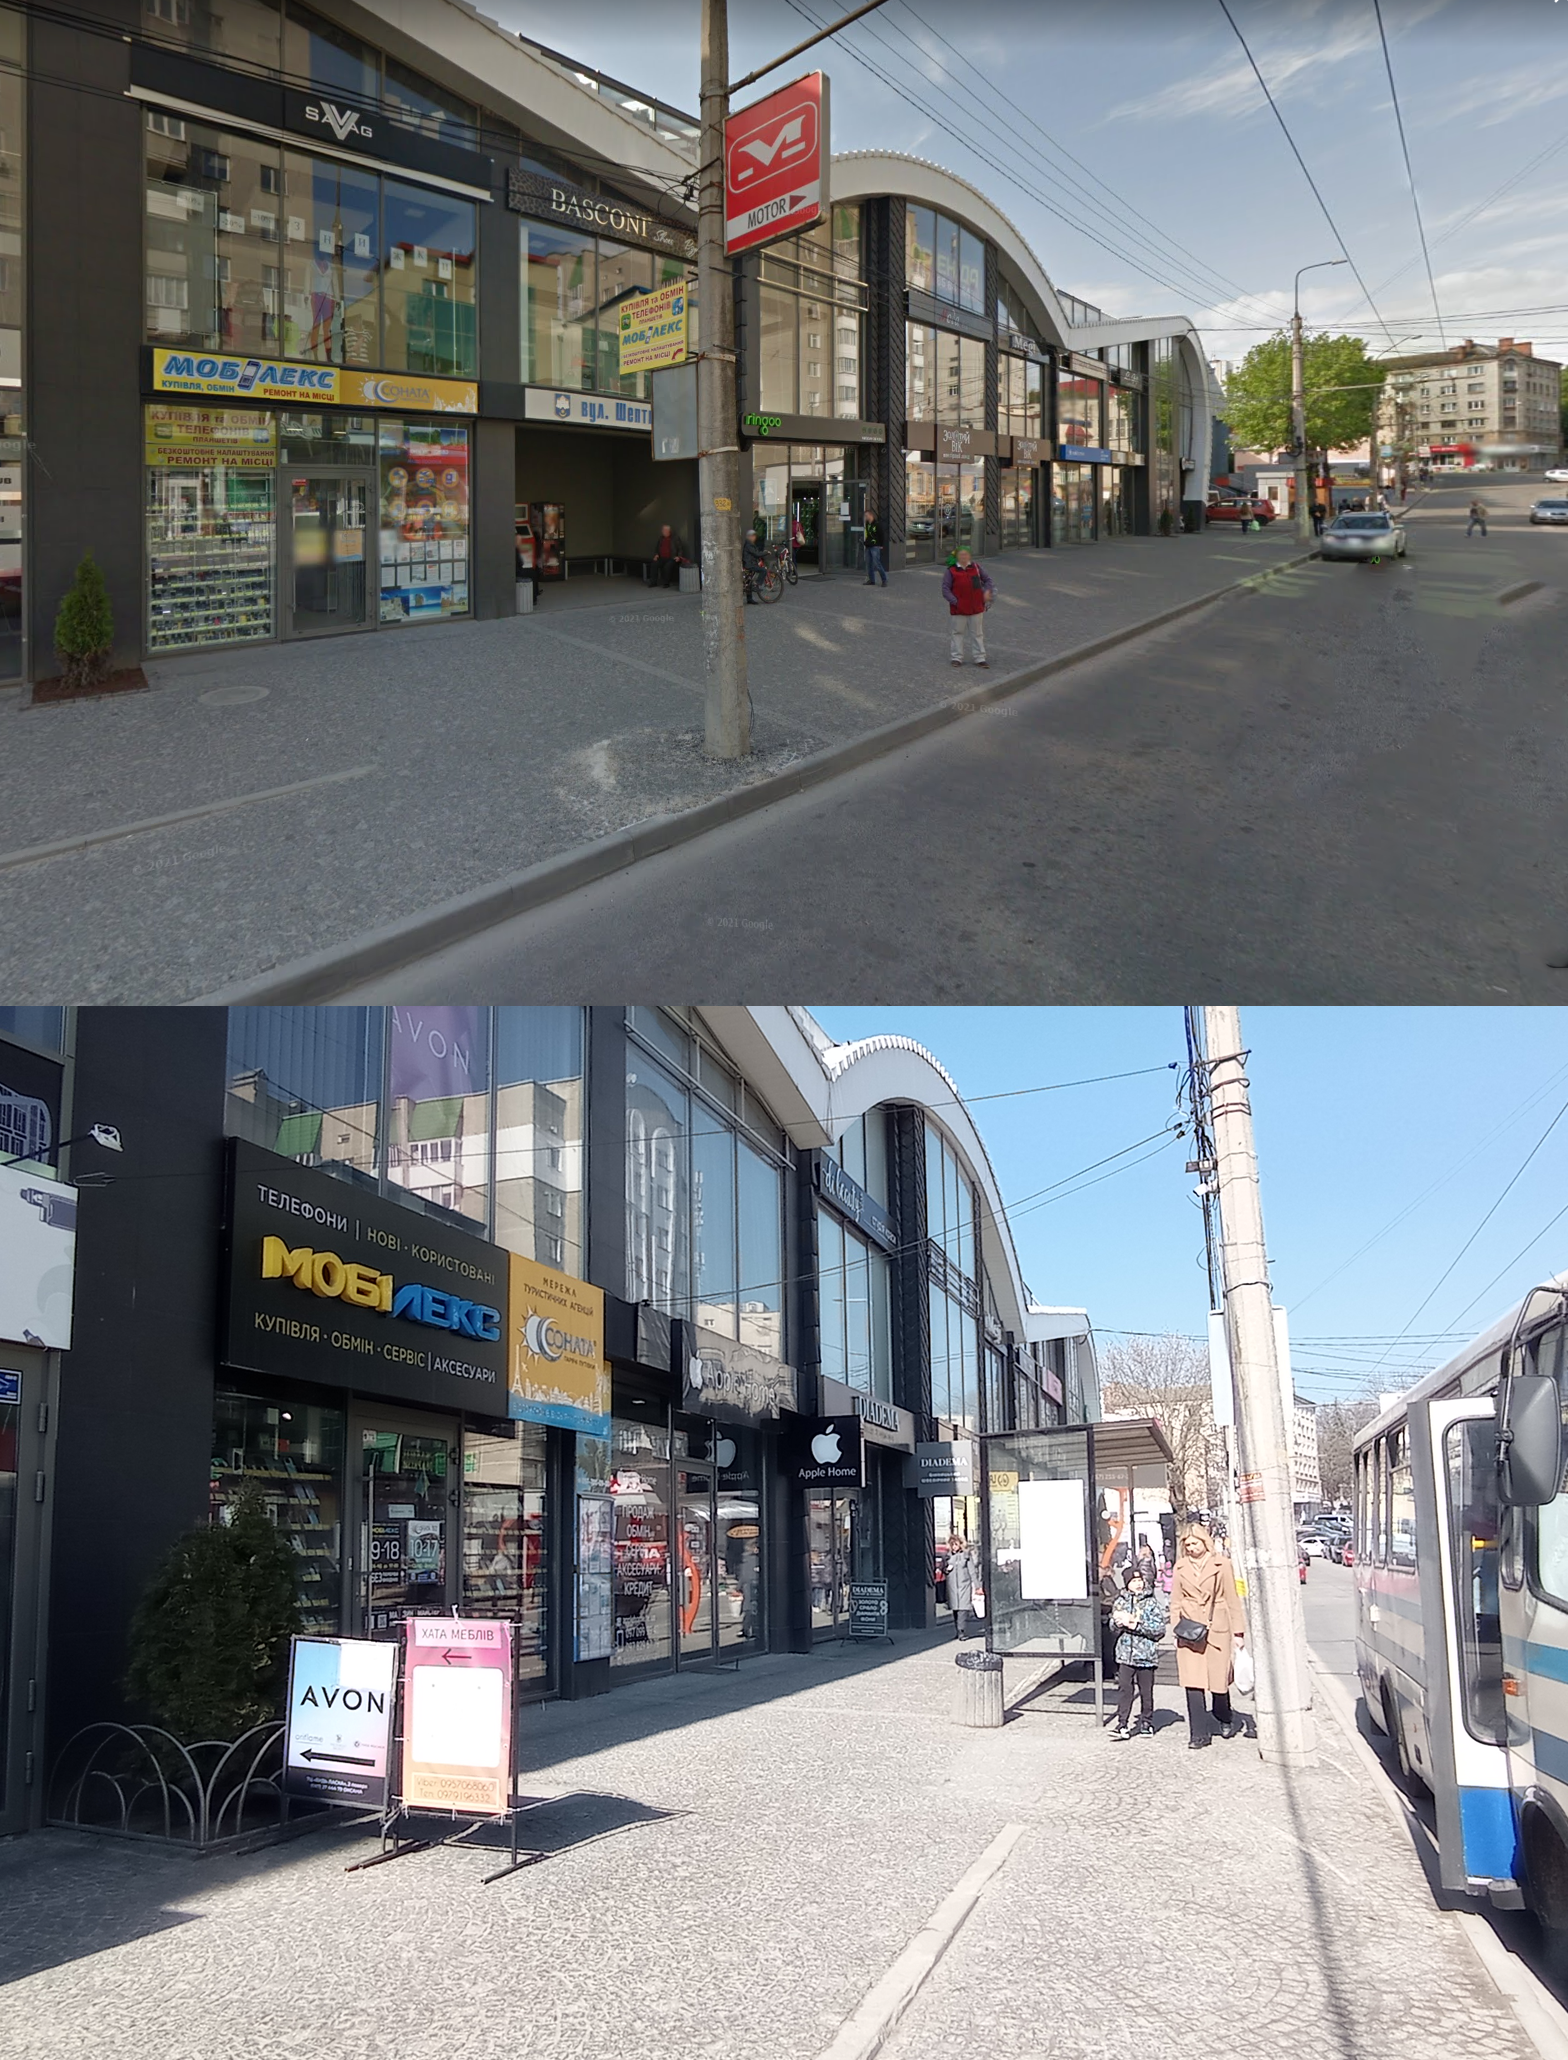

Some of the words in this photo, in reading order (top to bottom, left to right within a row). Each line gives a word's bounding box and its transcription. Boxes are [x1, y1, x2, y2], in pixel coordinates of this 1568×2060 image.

[551, 188, 652, 237] BASCONI
[747, 198, 787, 229] MOTOR
[621, 297, 650, 314] КУПІВЛЯ
[651, 296, 659, 306] та
[660, 286, 685, 302] ОБМІН
[632, 301, 672, 320] ТЕЛЕФОНІВ
[623, 356, 645, 367] РЕМОНТ
[645, 354, 653, 362] НА
[654, 351, 671, 362] МІСЦІ
[161, 380, 205, 392] КУПІВЛЯ,
[206, 384, 235, 393] ОБМІН
[379, 385, 431, 400] СОНАТА
[263, 388, 297, 399] РЕМОНТ
[298, 391, 310, 400] НА
[311, 392, 335, 402] МІСЦІ
[581, 401, 609, 423] вул.
[176, 424, 250, 437] ТЕЛЕФОНІВ
[744, 413, 782, 436] ringoo
[157, 447, 215, 456] БЕЗКОШТОВНЕ
[216, 449, 275, 457] НАЛАШТУВАННЯ
[167, 456, 218, 465] РЕМОНТ
[221, 458, 238, 466] НА
[240, 459, 273, 467] МІСЦІ
[257, 1184, 348, 1233] ТЕЛЕФОНИ
[367, 1227, 401, 1252] НОВІ
[411, 1243, 495, 1285] КОРИСТОВАНІ
[543, 1276, 577, 1298] МЕРЕЖА
[524, 1283, 568, 1308] ТУРИСТИЧНИХ
[570, 1302, 594, 1317] АГЕНЦІЙ
[254, 1312, 320, 1343] КУПІВЛЯ
[331, 1331, 374, 1355] ОБМІН
[383, 1344, 426, 1368] СЕРВІС
[434, 1358, 496, 1383] АКСЕСУАРИ
[545, 1326, 596, 1359] СОНАТА
[860, 1396, 900, 1432] DIADEMA
[921, 1457, 969, 1468] DIADEMA
[798, 1468, 826, 1480] Apple
[828, 1467, 857, 1477] Home
[622, 1505, 655, 1520] ПРОДАЖ
[626, 1524, 651, 1538] ОБМІН
[371, 1541, 400, 1560] 9-18
[617, 1562, 661, 1576] АКСЕСУАРИ
[624, 1581, 654, 1597] КРЕДИТ
[421, 1628, 447, 1640] ХАТА
[451, 1628, 495, 1641] МЕБЛІВ
[300, 1685, 385, 1714] AVON
[437, 1790, 491, 1803] 0979196332
